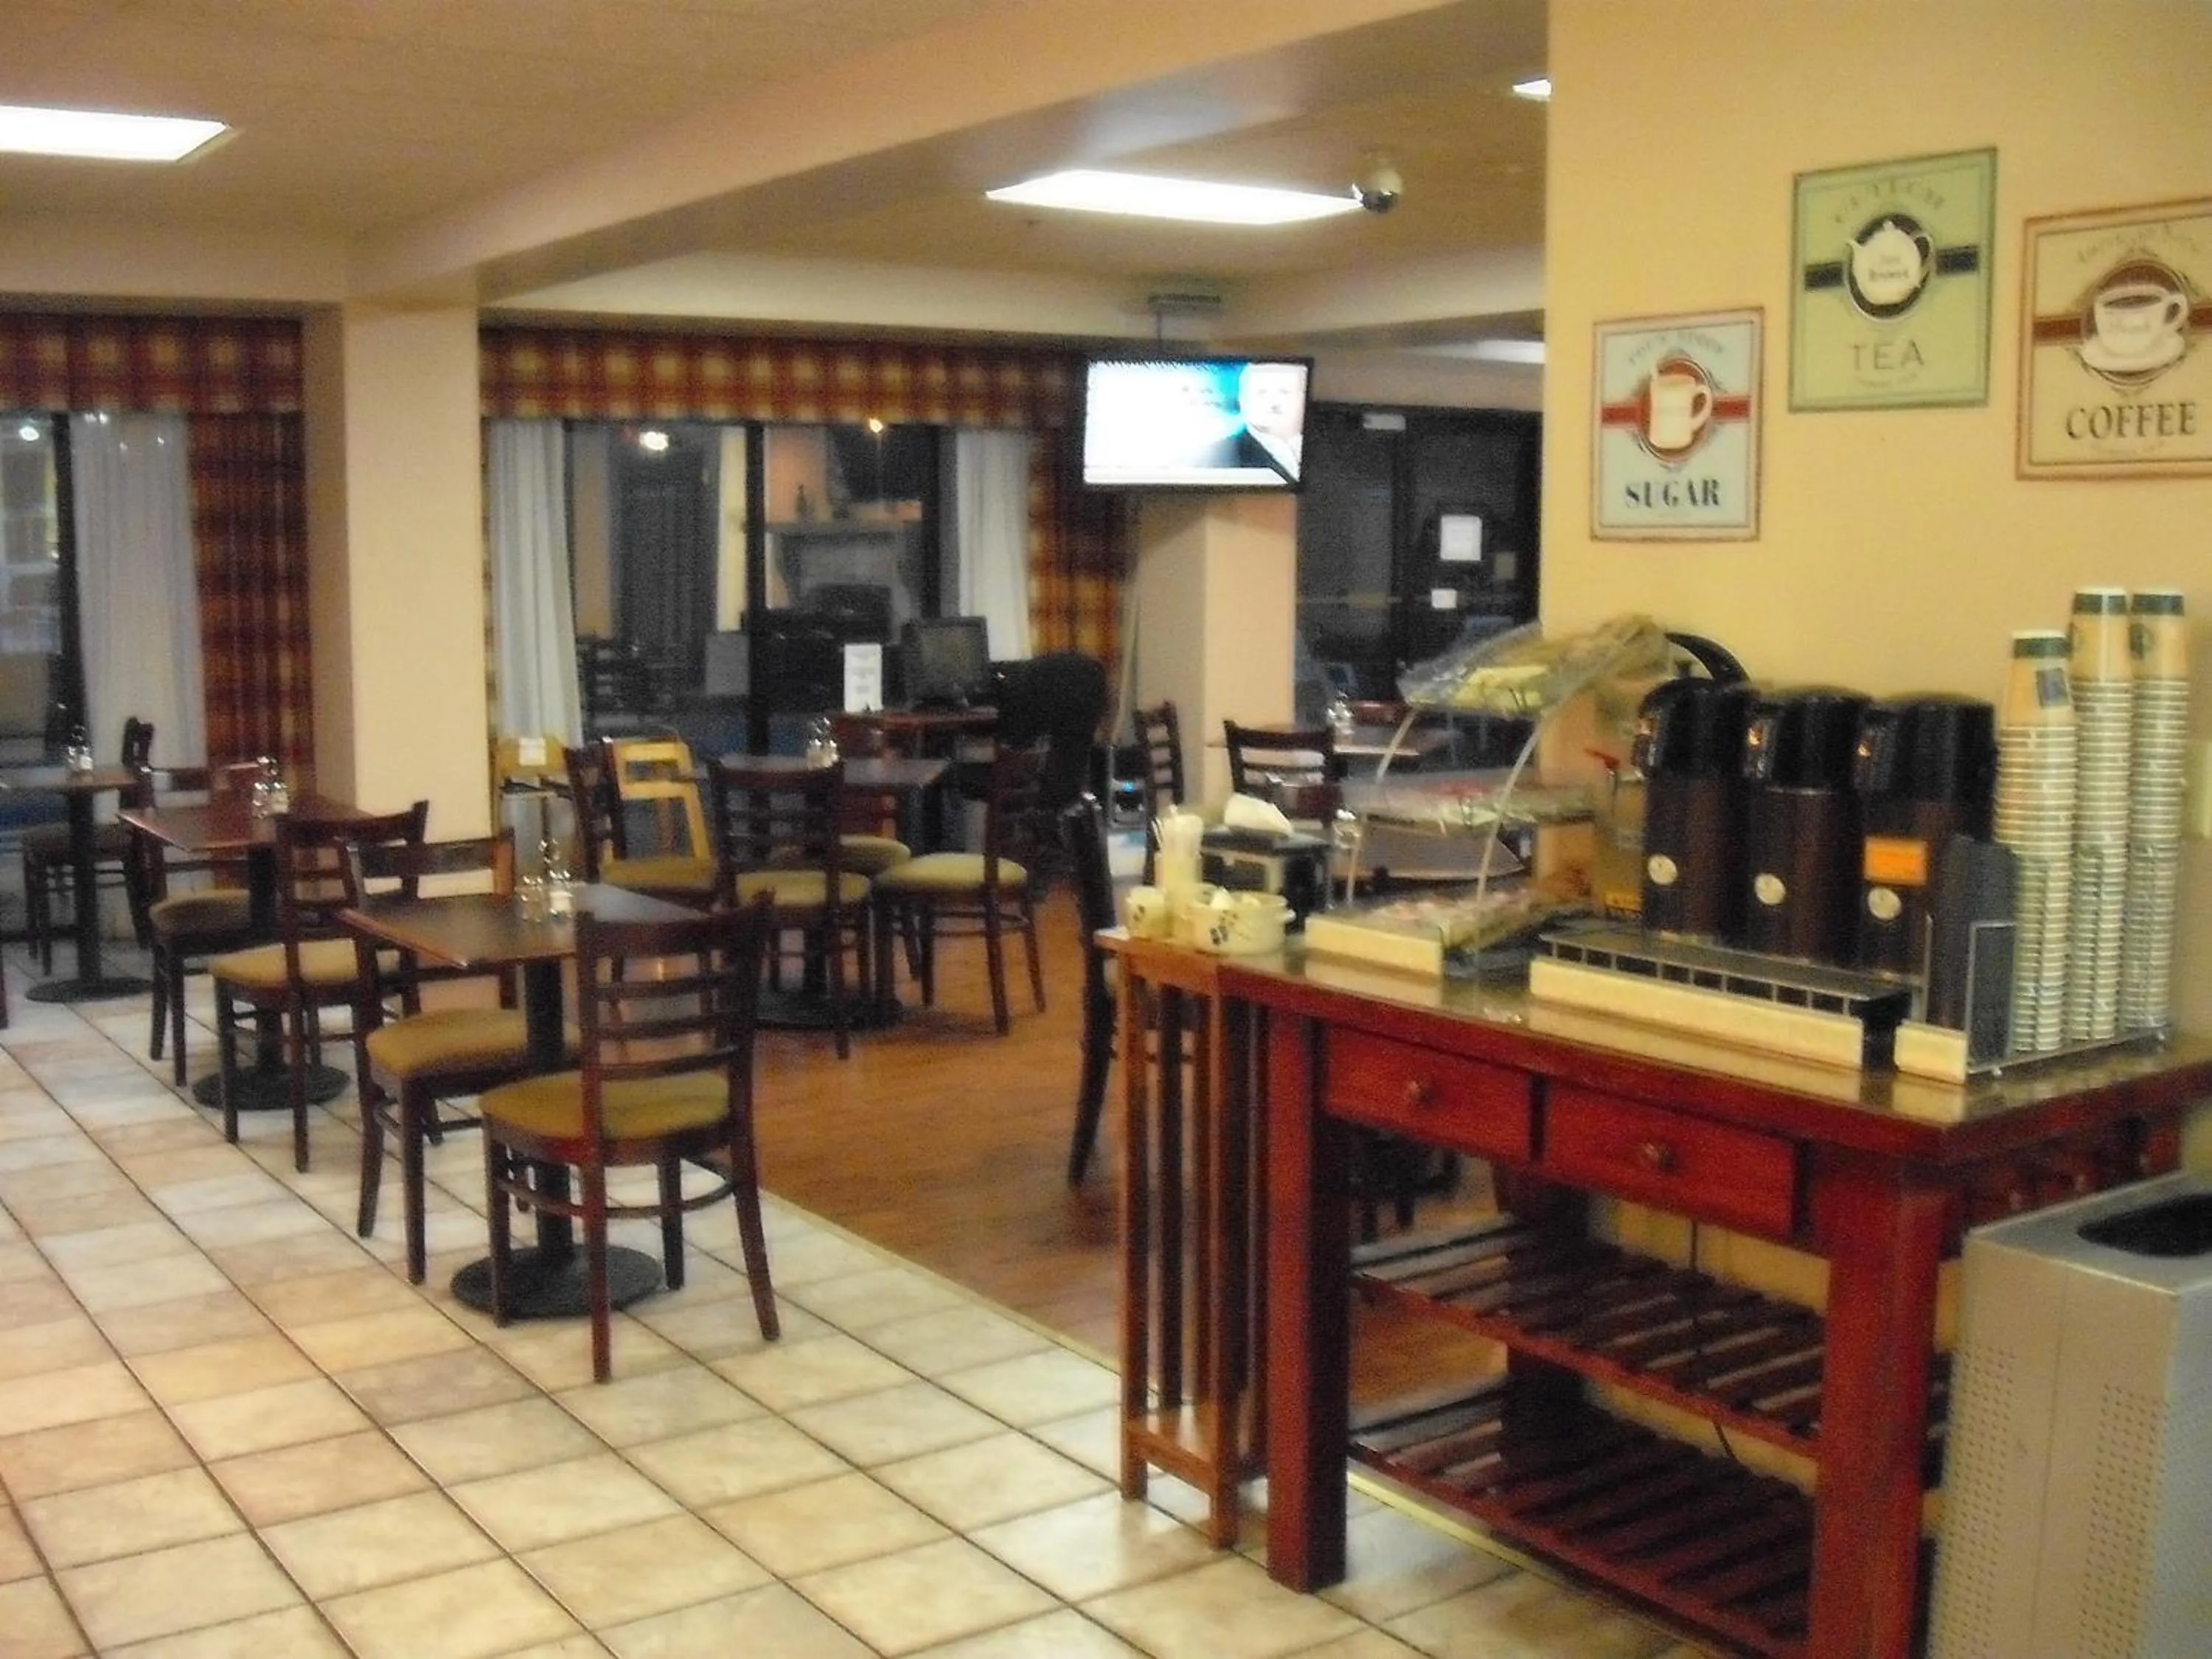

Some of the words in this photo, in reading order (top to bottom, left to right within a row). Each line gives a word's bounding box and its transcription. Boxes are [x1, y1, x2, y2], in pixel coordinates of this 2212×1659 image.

[1848, 339, 1924, 370] TEA
[2066, 402, 2196, 439] COFFEE
[1625, 479, 1720, 508] SUGAR
